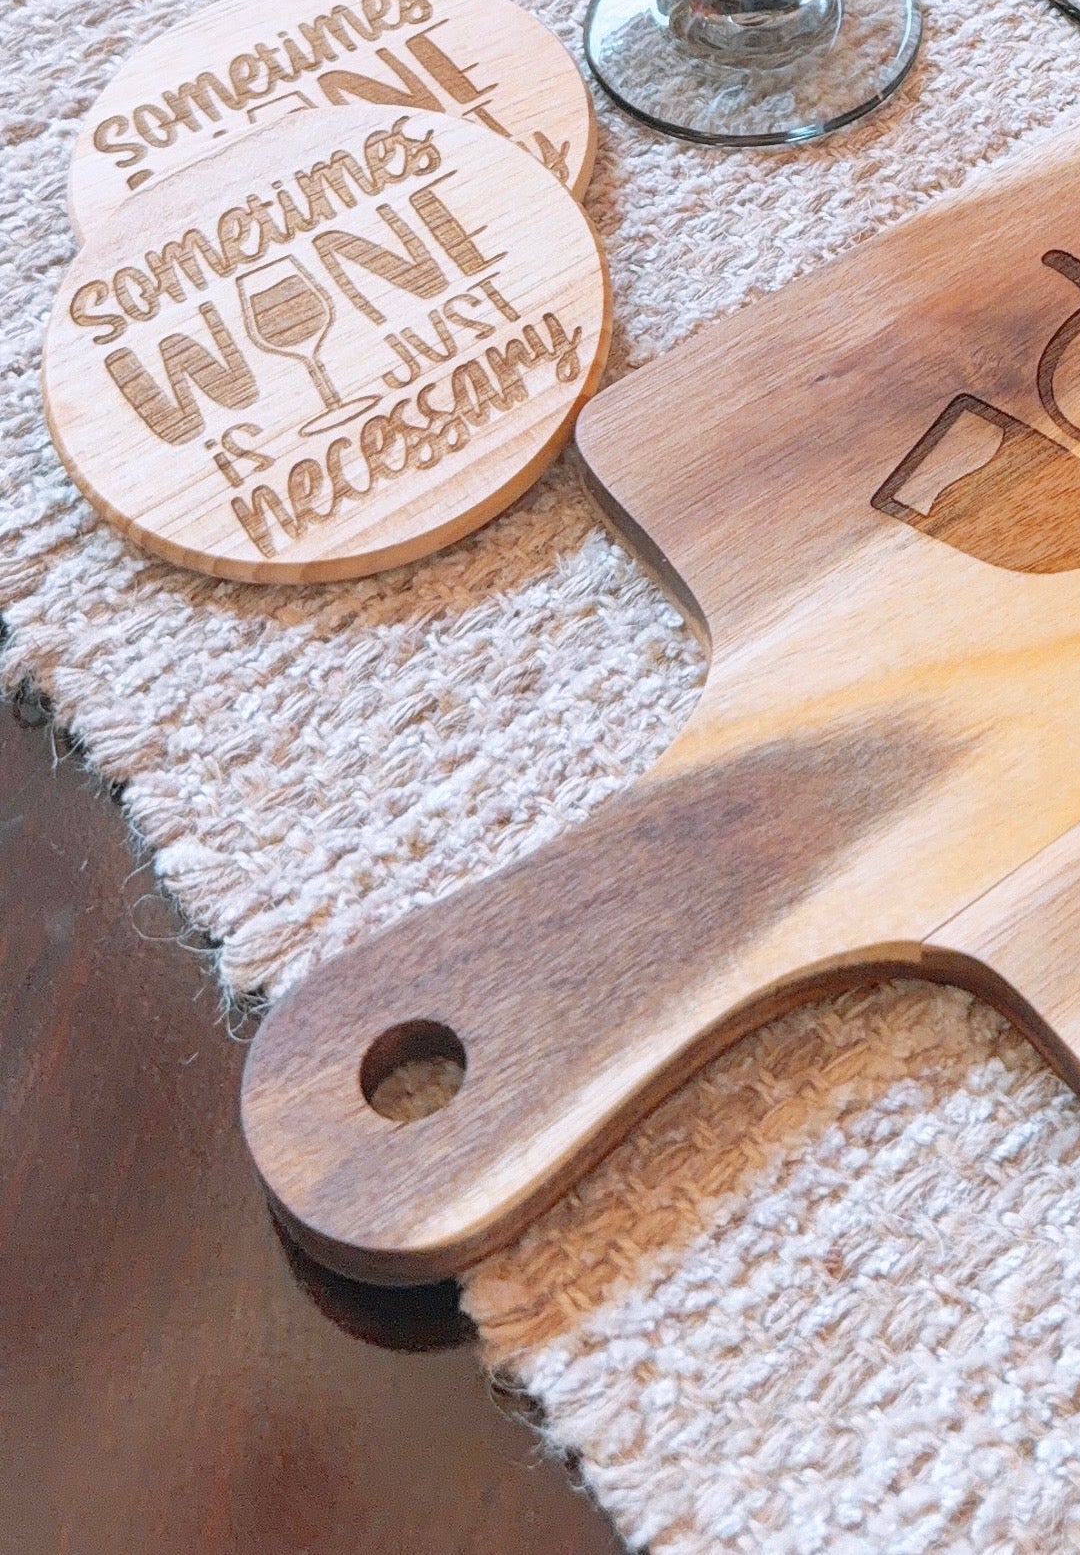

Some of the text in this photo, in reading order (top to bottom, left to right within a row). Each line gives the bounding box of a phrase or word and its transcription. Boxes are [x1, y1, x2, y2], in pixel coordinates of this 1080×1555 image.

[70, 116, 442, 345] sometimes
[380, 272, 521, 389] JUST
[231, 312, 582, 558] necessary
